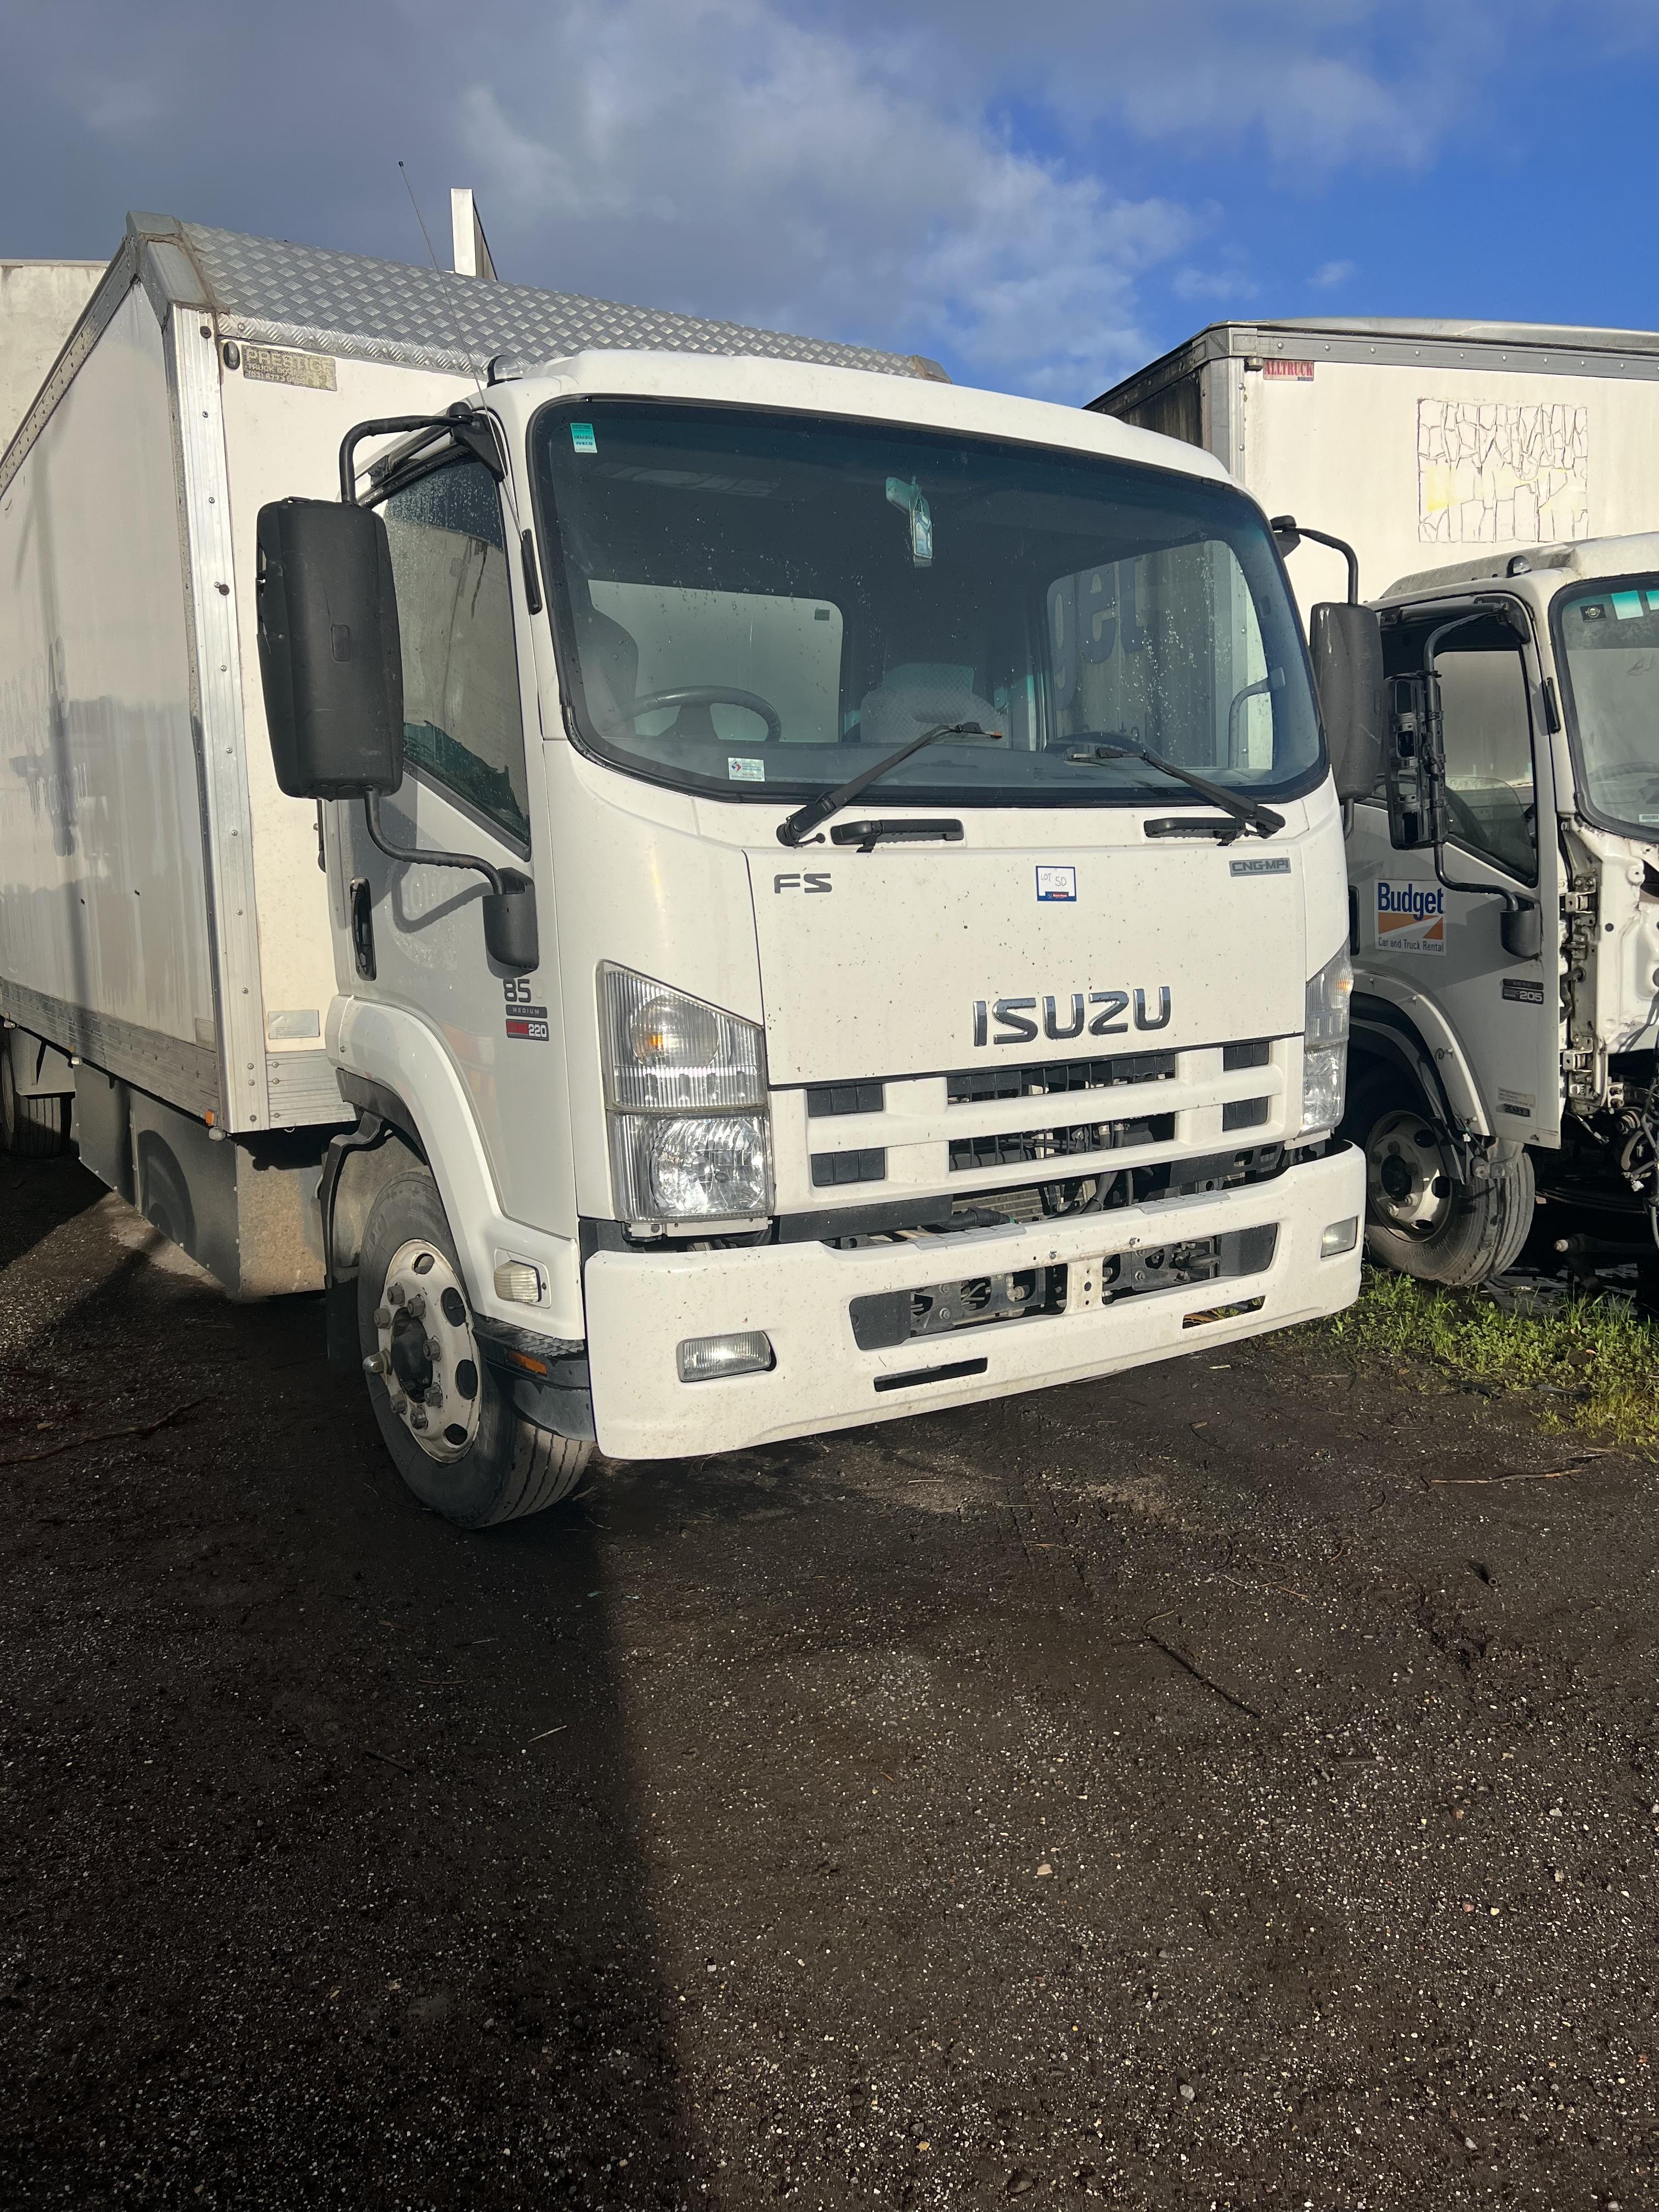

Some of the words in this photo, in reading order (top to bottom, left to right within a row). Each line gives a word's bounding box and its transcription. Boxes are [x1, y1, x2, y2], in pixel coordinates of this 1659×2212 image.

[246, 363, 275, 373] TRUCK
[1265, 360, 1313, 376] ALLTRUCK
[774, 873, 833, 894] FS
[1041, 873, 1052, 882] LOT
[1378, 882, 1444, 921] Budget
[1378, 937, 1389, 947] Car
[1390, 939, 1401, 949] and
[1403, 939, 1420, 951] Truck
[1423, 940, 1444, 952] Rental
[1520, 990, 1543, 1002] 205
[973, 986, 1171, 1047] ISUZU
[528, 1023, 547, 1038] 220
